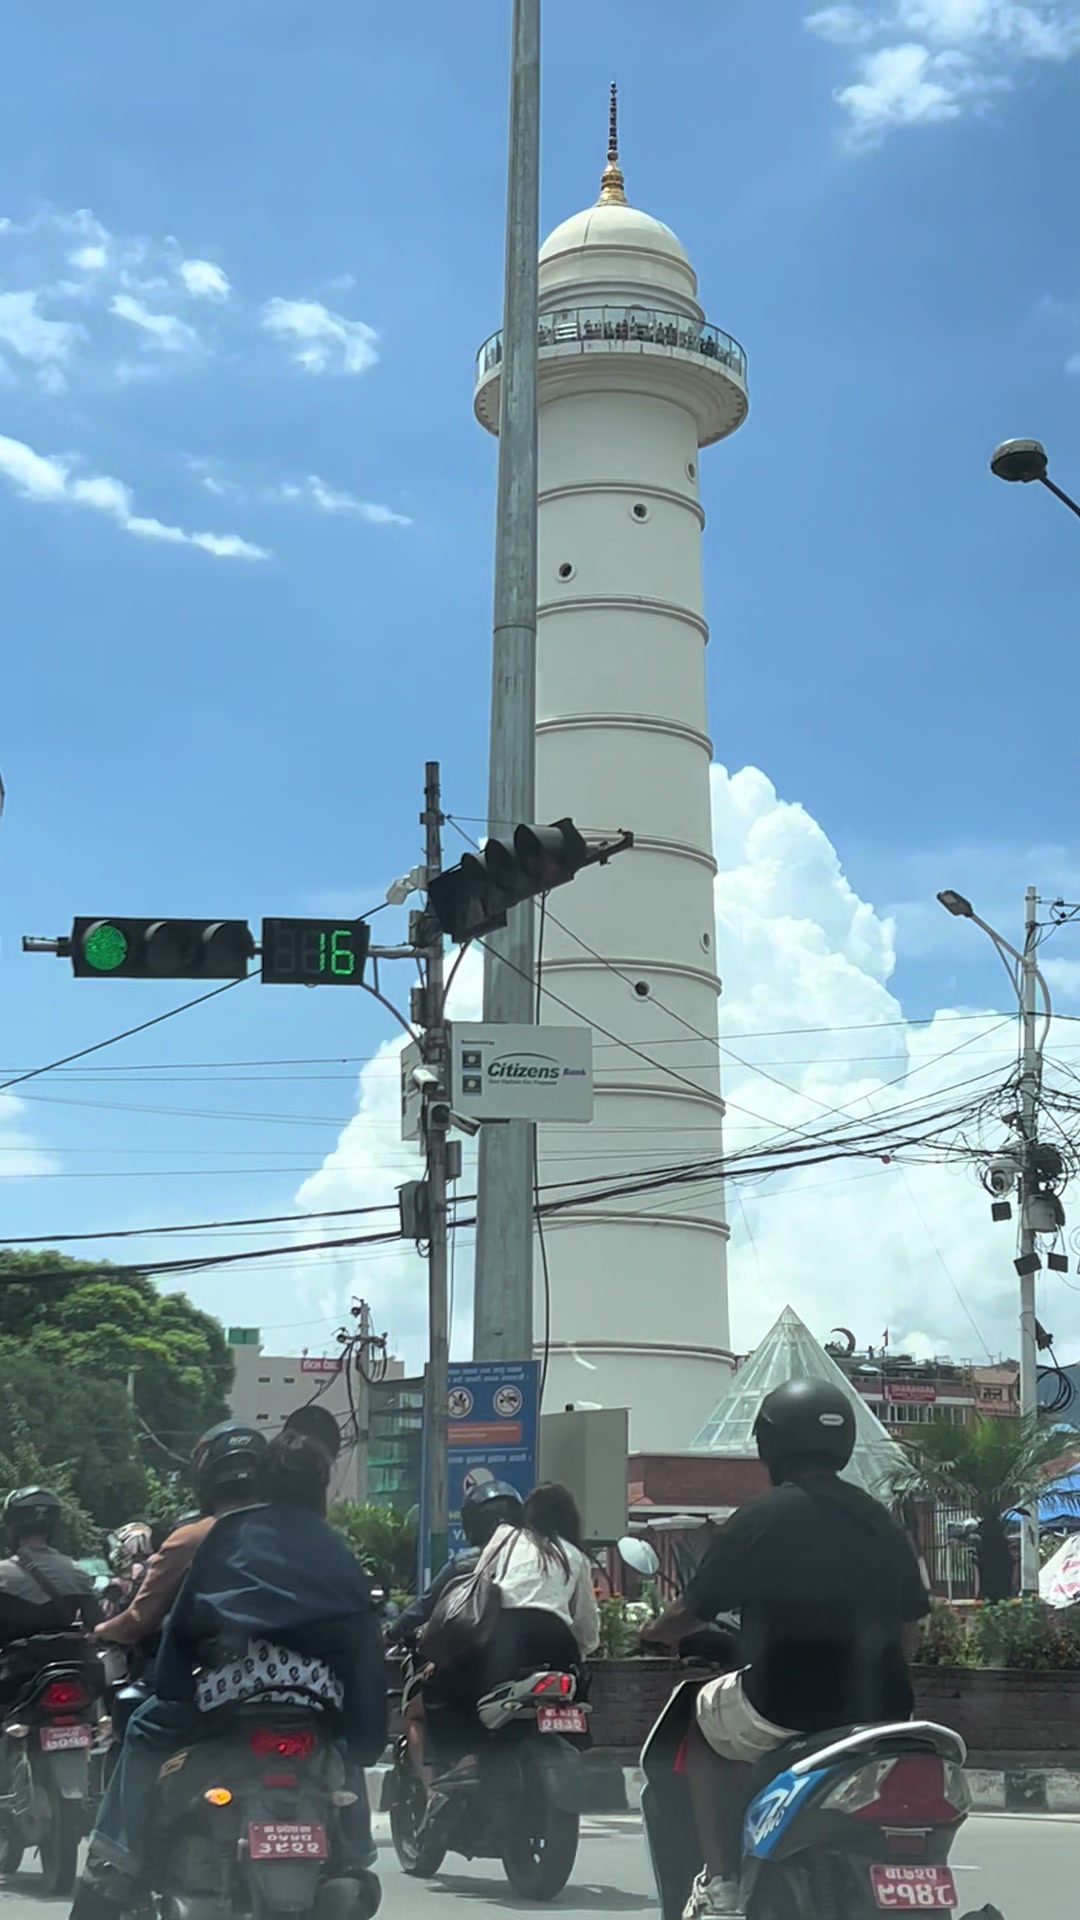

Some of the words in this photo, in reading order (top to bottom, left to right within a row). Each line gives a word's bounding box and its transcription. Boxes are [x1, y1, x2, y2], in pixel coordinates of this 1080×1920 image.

[319, 930, 354, 975] 16
[487, 1062, 560, 1079] Citizens
[563, 1067, 586, 1076] Bank
